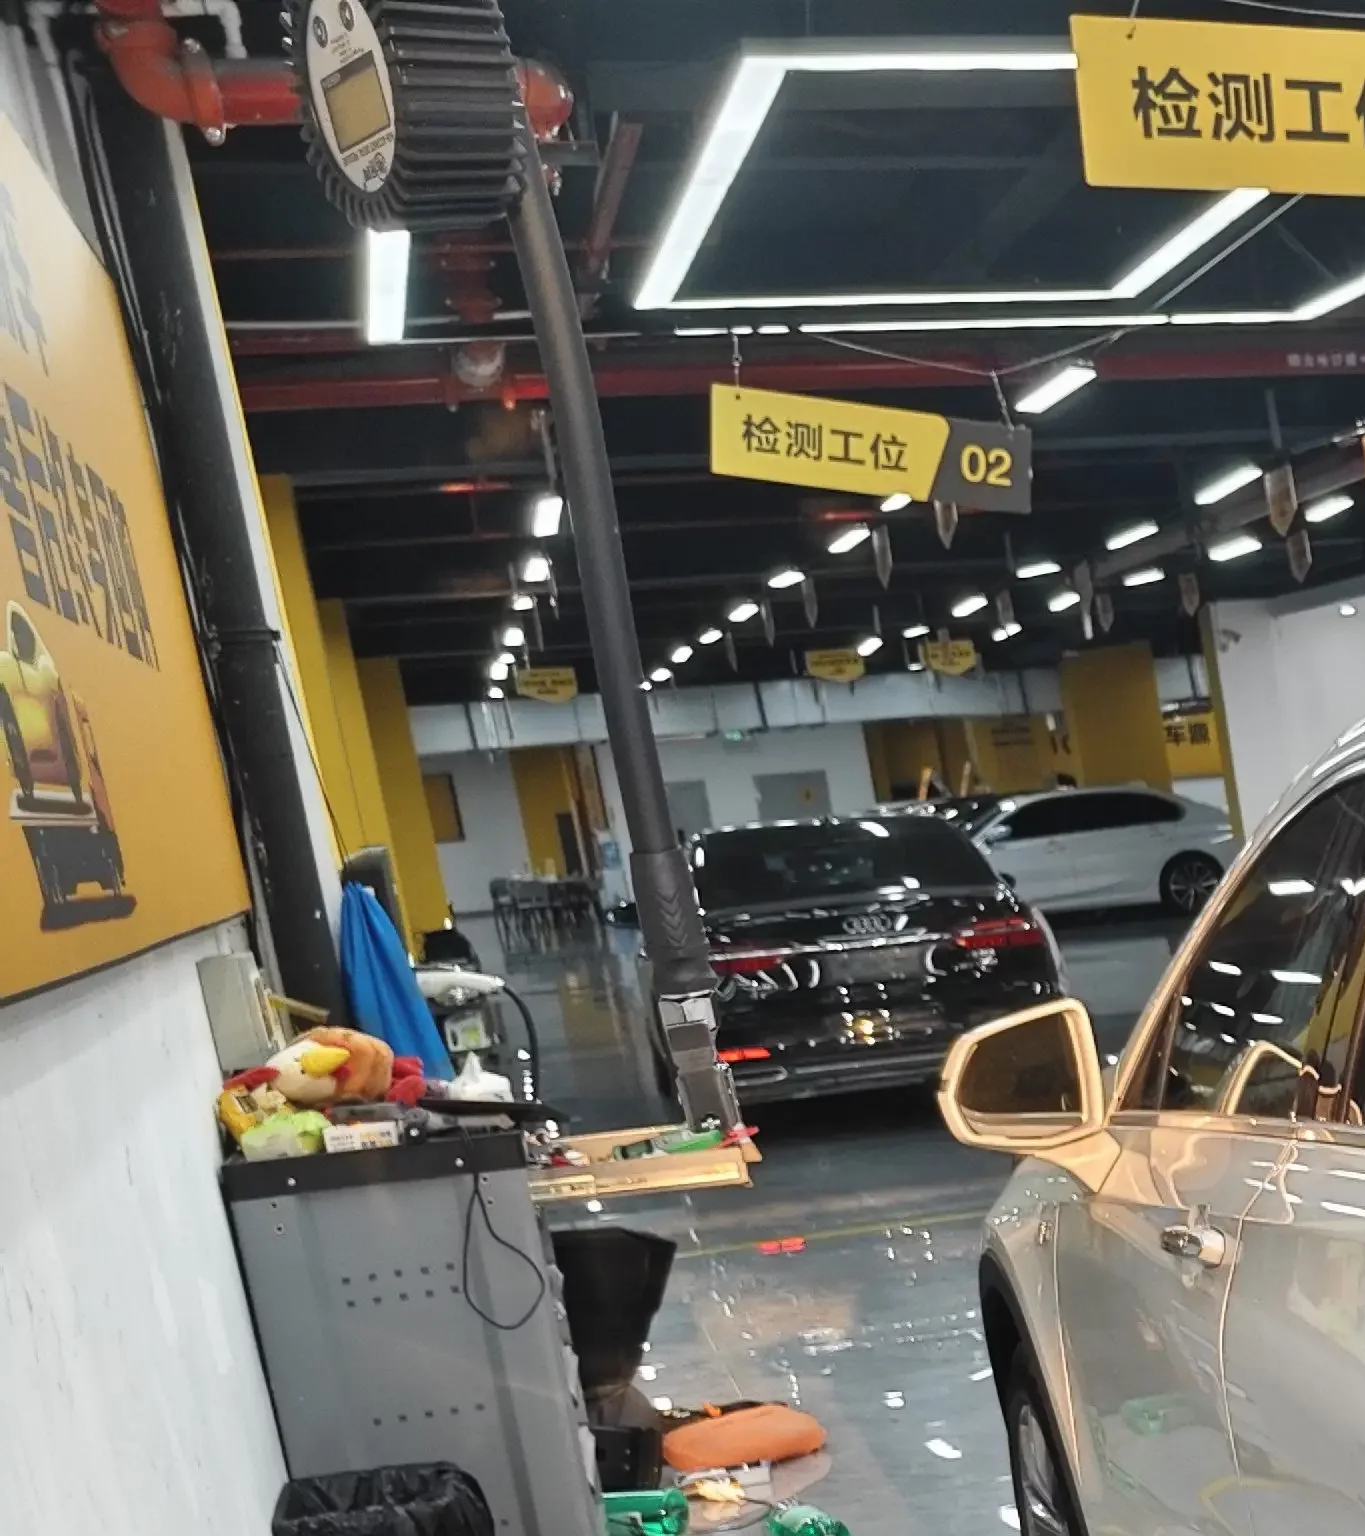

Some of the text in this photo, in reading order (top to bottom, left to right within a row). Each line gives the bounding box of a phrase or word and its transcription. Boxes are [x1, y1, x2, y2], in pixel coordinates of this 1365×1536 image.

[742, 414, 1012, 487] 检测工位 02
